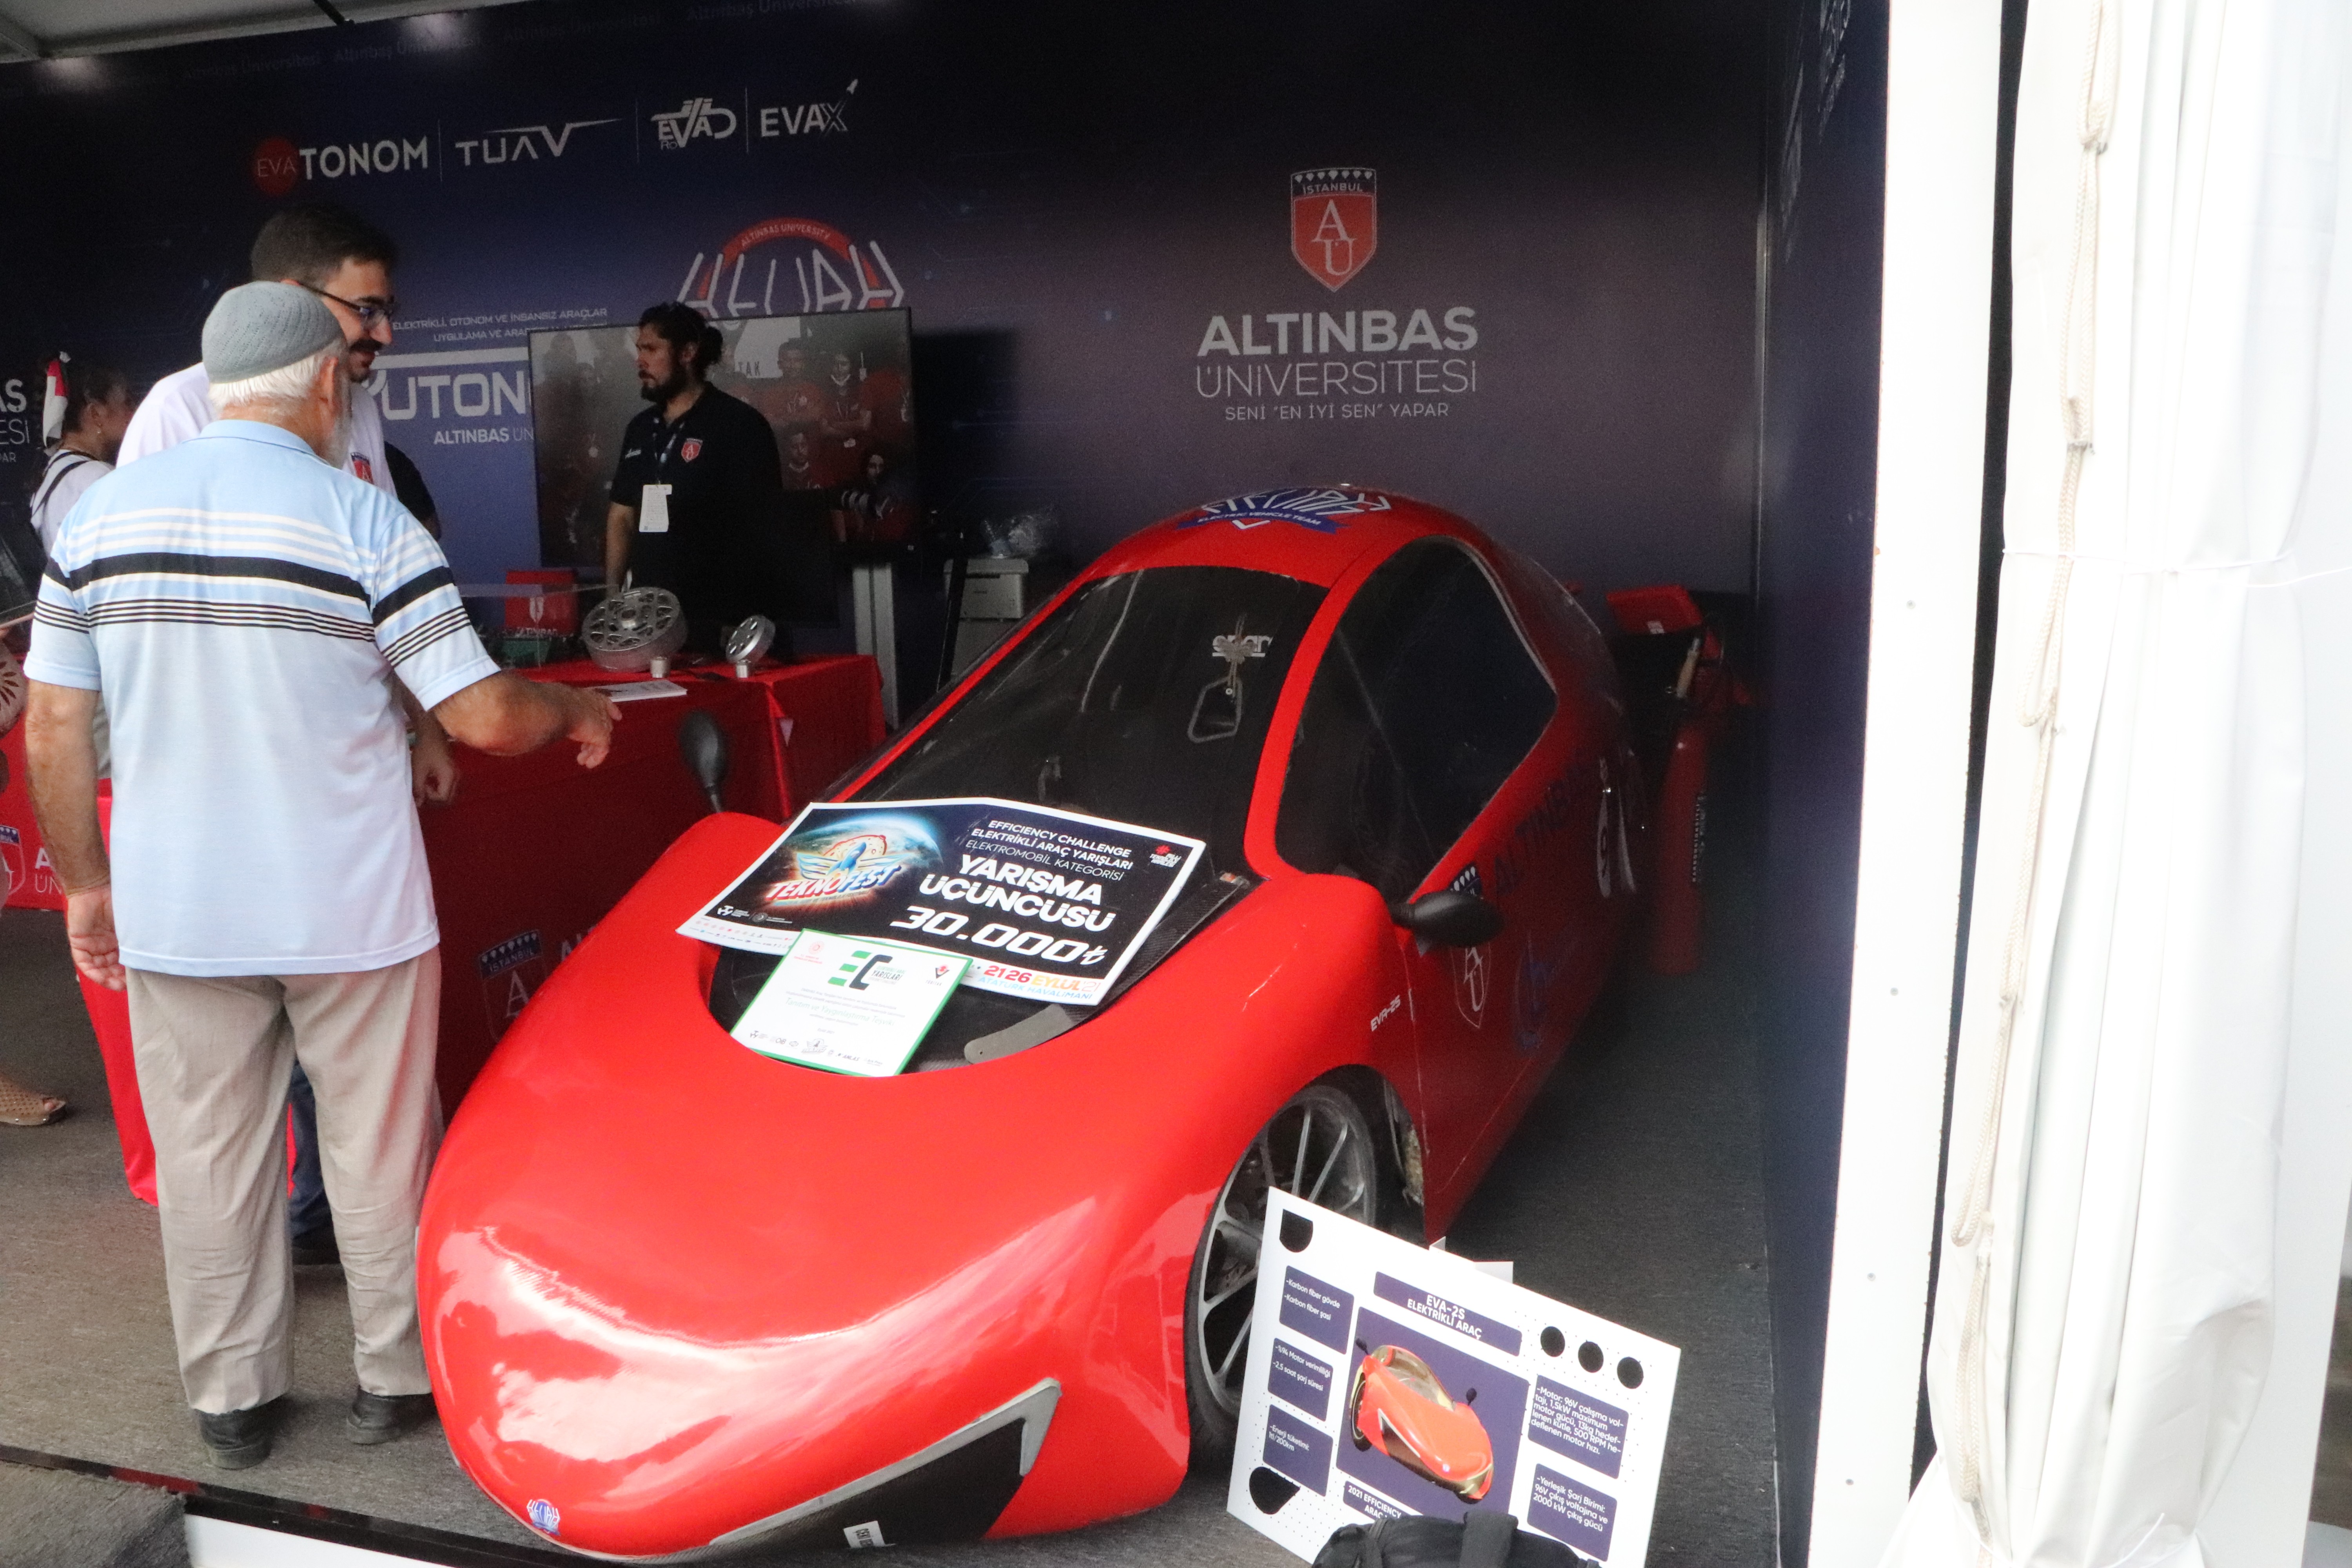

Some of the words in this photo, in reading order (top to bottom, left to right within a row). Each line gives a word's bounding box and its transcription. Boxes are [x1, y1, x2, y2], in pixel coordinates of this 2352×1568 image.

[256, 158, 296, 178] EVA
[299, 136, 430, 181] TONOM
[450, 316, 493, 327] OTONOM
[495, 314, 508, 324] VE
[489, 330, 502, 338] VE
[1390, 403, 1449, 417] YAPAR
[1293, 515, 1321, 525] TEAM
[971, 828, 1038, 848] ELEKTRİKLİ
[1039, 841, 1071, 858] ARAÇ
[1071, 849, 1134, 870] YARIŞLARI
[988, 820, 1057, 841] EFFICIENCY
[1058, 834, 1132, 858] CHALLENGE
[766, 865, 902, 901] TEKNOFEST
[958, 854, 1104, 906] YARIŞMA
[919, 874, 1116, 933] ÜÇÜNCÜSÜ
[1031, 975, 1081, 991] EYLÜL
[1371, 995, 1401, 1032] EVA-2S
[1306, 1303, 1320, 1315] fiber
[1308, 1288, 1321, 1300] fiber
[1322, 1294, 1341, 1309] gövde
[1426, 1294, 1465, 1320] EVA-2S
[1407, 1298, 1455, 1327] ELEKTRİKLİ
[1455, 1321, 1483, 1340] ARAÇ
[1289, 1351, 1305, 1364] Motor
[1533, 1402, 1555, 1416] motor
[1564, 1397, 1579, 1409] 96V
[1531, 1418, 1563, 1438] deflenen
[1563, 1433, 1585, 1448] motor
[1532, 1411, 1553, 1425] lenen
[1573, 1428, 1589, 1441] 500
[1589, 1433, 1606, 1448] RPM
[1571, 1409, 1608, 1431] maximum
[1348, 1485, 1363, 1499] 2021
[1363, 1493, 1402, 1519] EFFICIENCY
[1533, 1494, 1553, 1508] 2000
[1553, 1501, 1566, 1514] kW
[1535, 1483, 1549, 1495] 96V
[1599, 1515, 1608, 1523] ve
